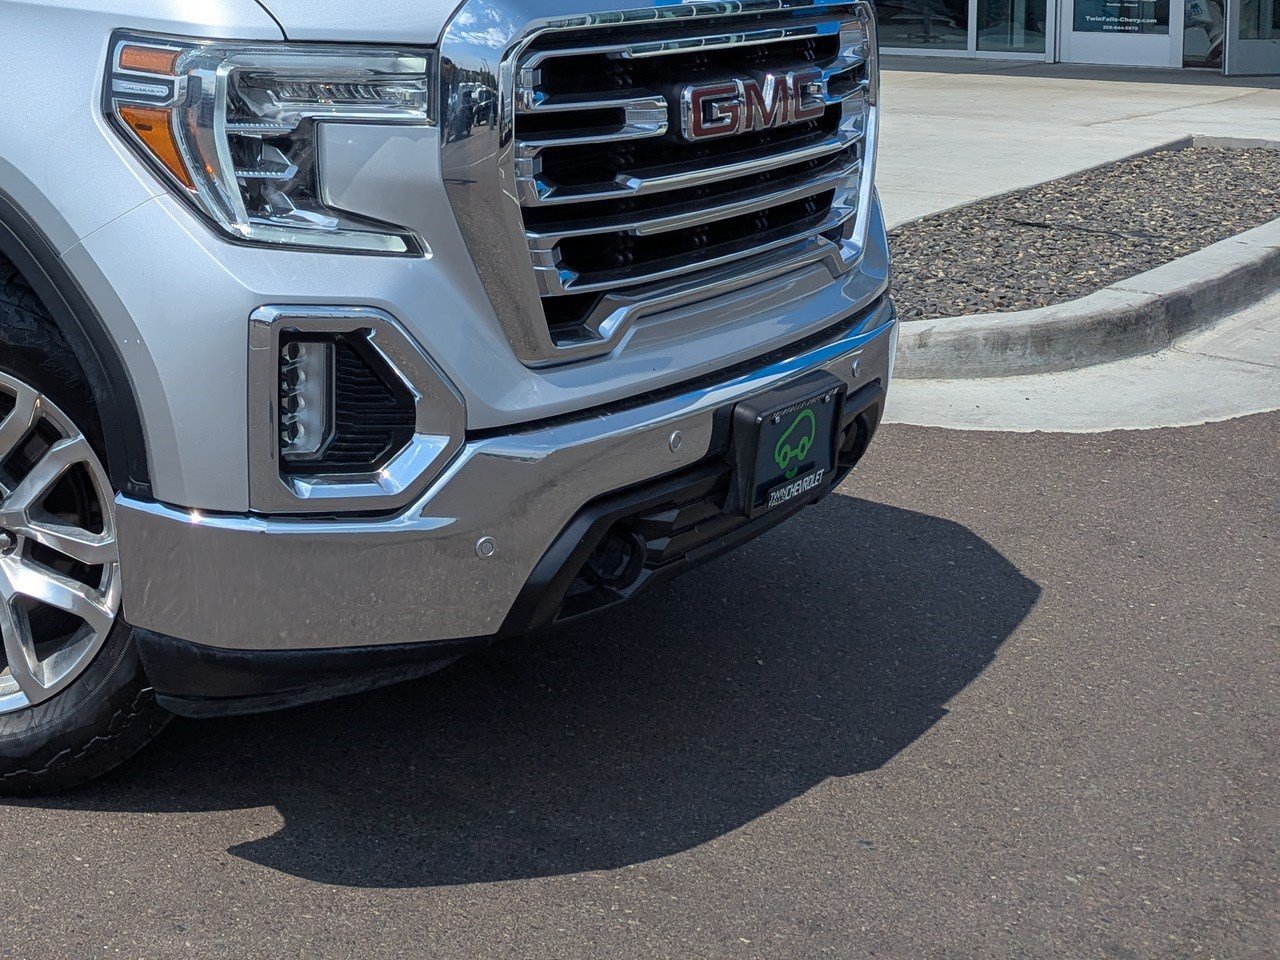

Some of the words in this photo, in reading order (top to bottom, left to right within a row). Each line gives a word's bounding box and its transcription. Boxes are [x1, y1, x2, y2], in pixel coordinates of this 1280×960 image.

[1085, 16, 1157, 24] TwinFalls-Chevy.com
[681, 66, 826, 141] GMC
[784, 468, 825, 500] CHEVROLET
